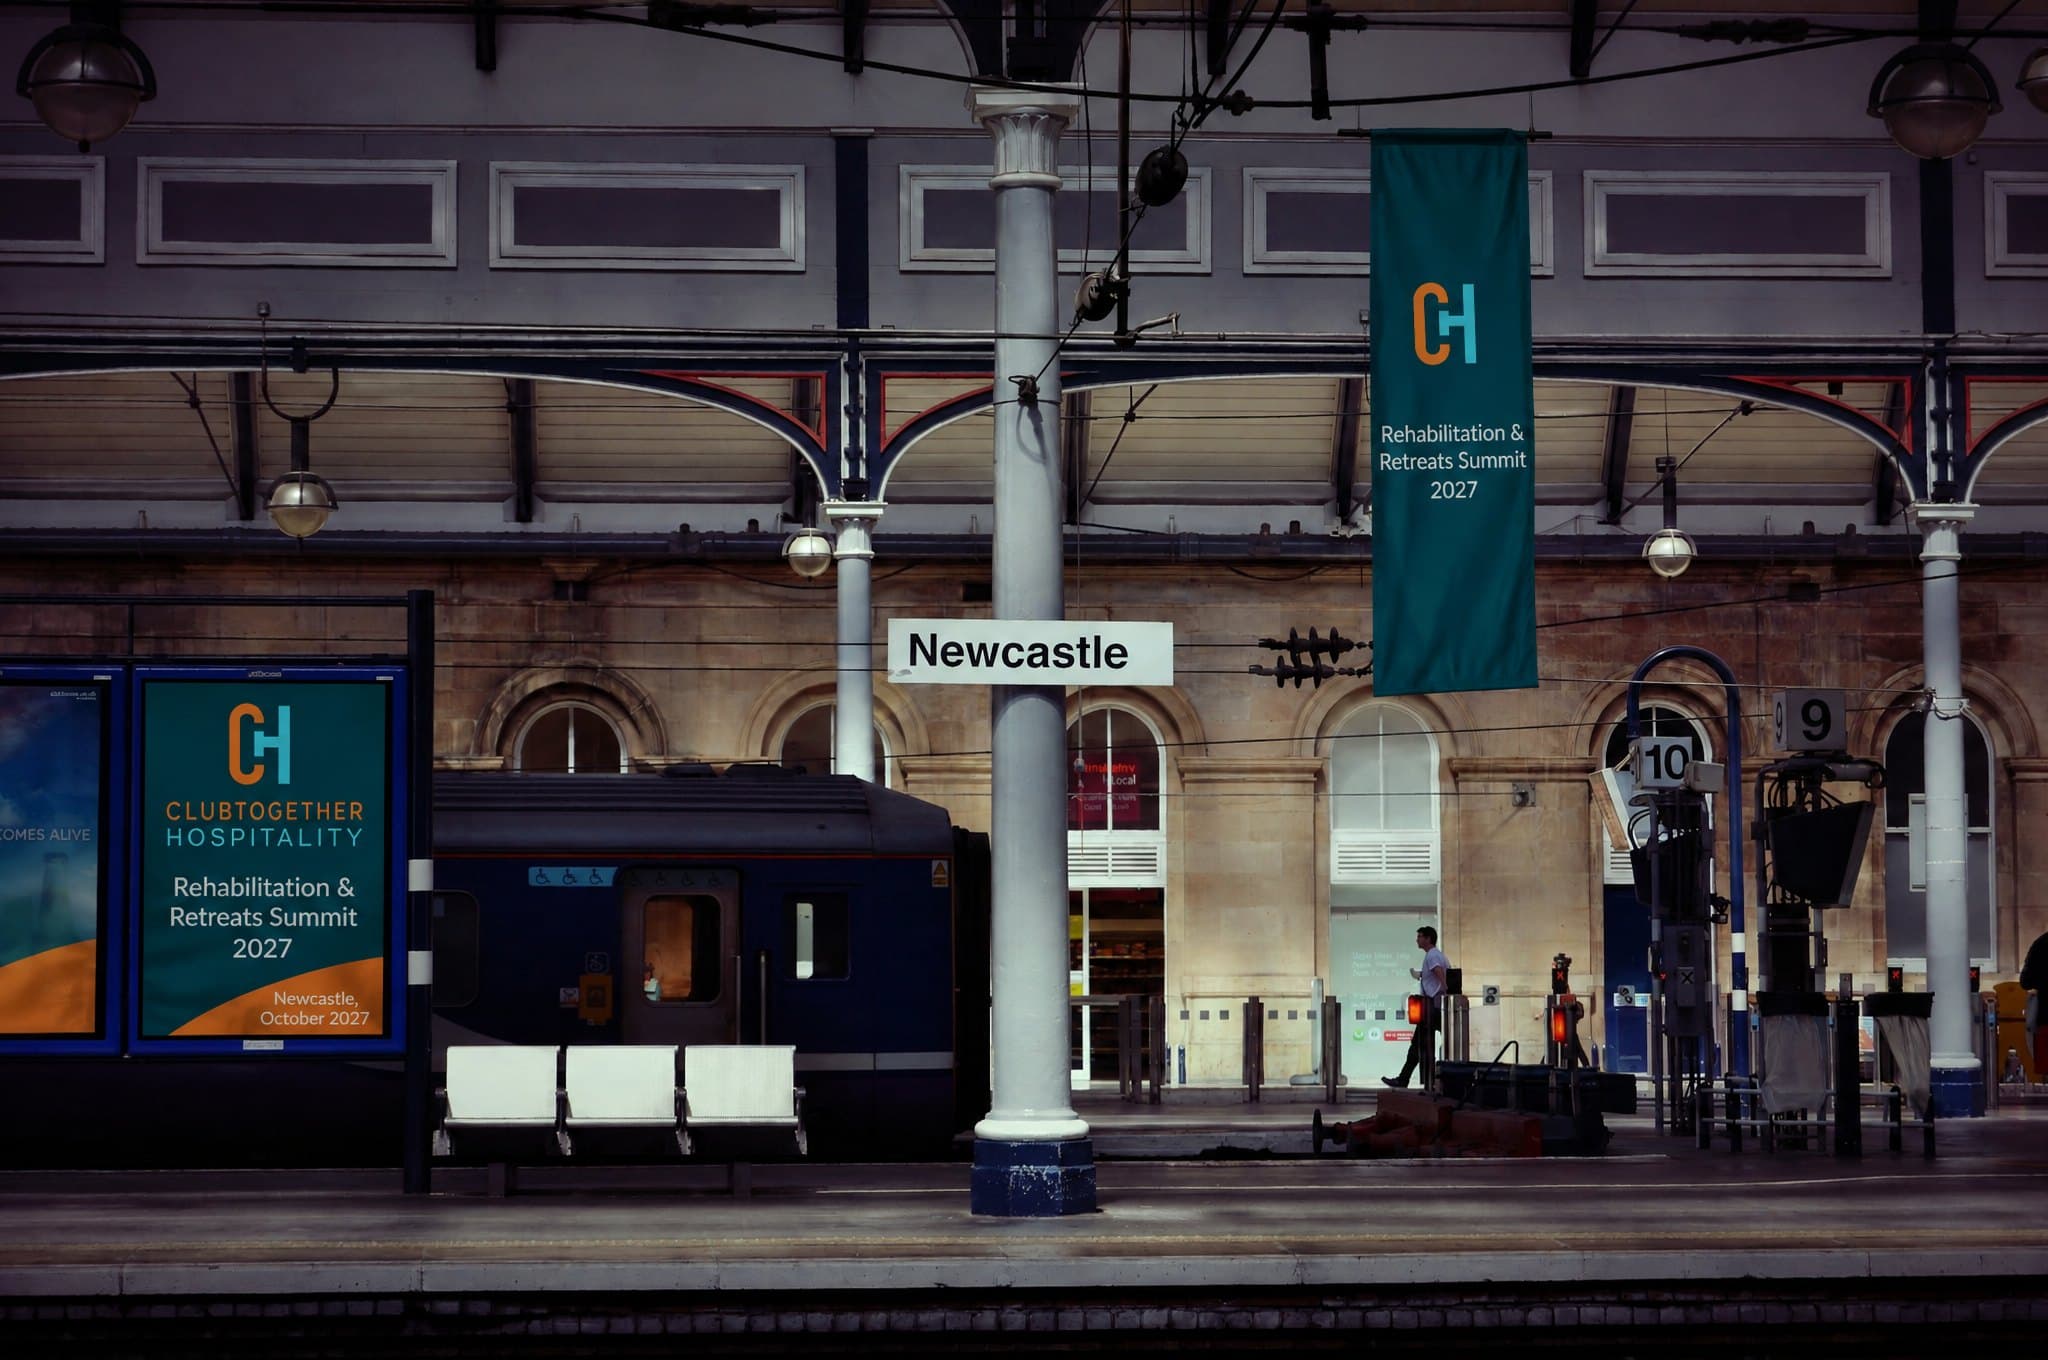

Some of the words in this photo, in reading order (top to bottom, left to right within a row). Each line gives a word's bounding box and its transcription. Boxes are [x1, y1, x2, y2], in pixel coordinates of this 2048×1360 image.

[1413, 282, 1477, 366] CH
[1381, 424, 1505, 443] Rehabilitation
[1510, 424, 1524, 441] &
[1380, 452, 1454, 471] Retreats
[1458, 450, 1527, 470] Summit
[1430, 480, 1478, 499] 2027
[909, 632, 1129, 670] Newcastle
[1802, 699, 1831, 741] 9
[228, 703, 291, 785] CH
[1645, 744, 1690, 780] 10
[166, 802, 364, 820] CLUBTOGETHER
[0, 828, 45, 841] OMES
[49, 828, 91, 841] ALIVE
[166, 828, 363, 847] HOSPITALITY
[174, 876, 329, 897] Rehabilitation
[337, 877, 355, 897] &
[170, 907, 263, 927] Retreats
[269, 906, 358, 927] Summit
[233, 938, 293, 959] 2027
[274, 991, 359, 1008] Newcastle,
[260, 1011, 325, 1026] October
[329, 1011, 370, 1025] 2027
